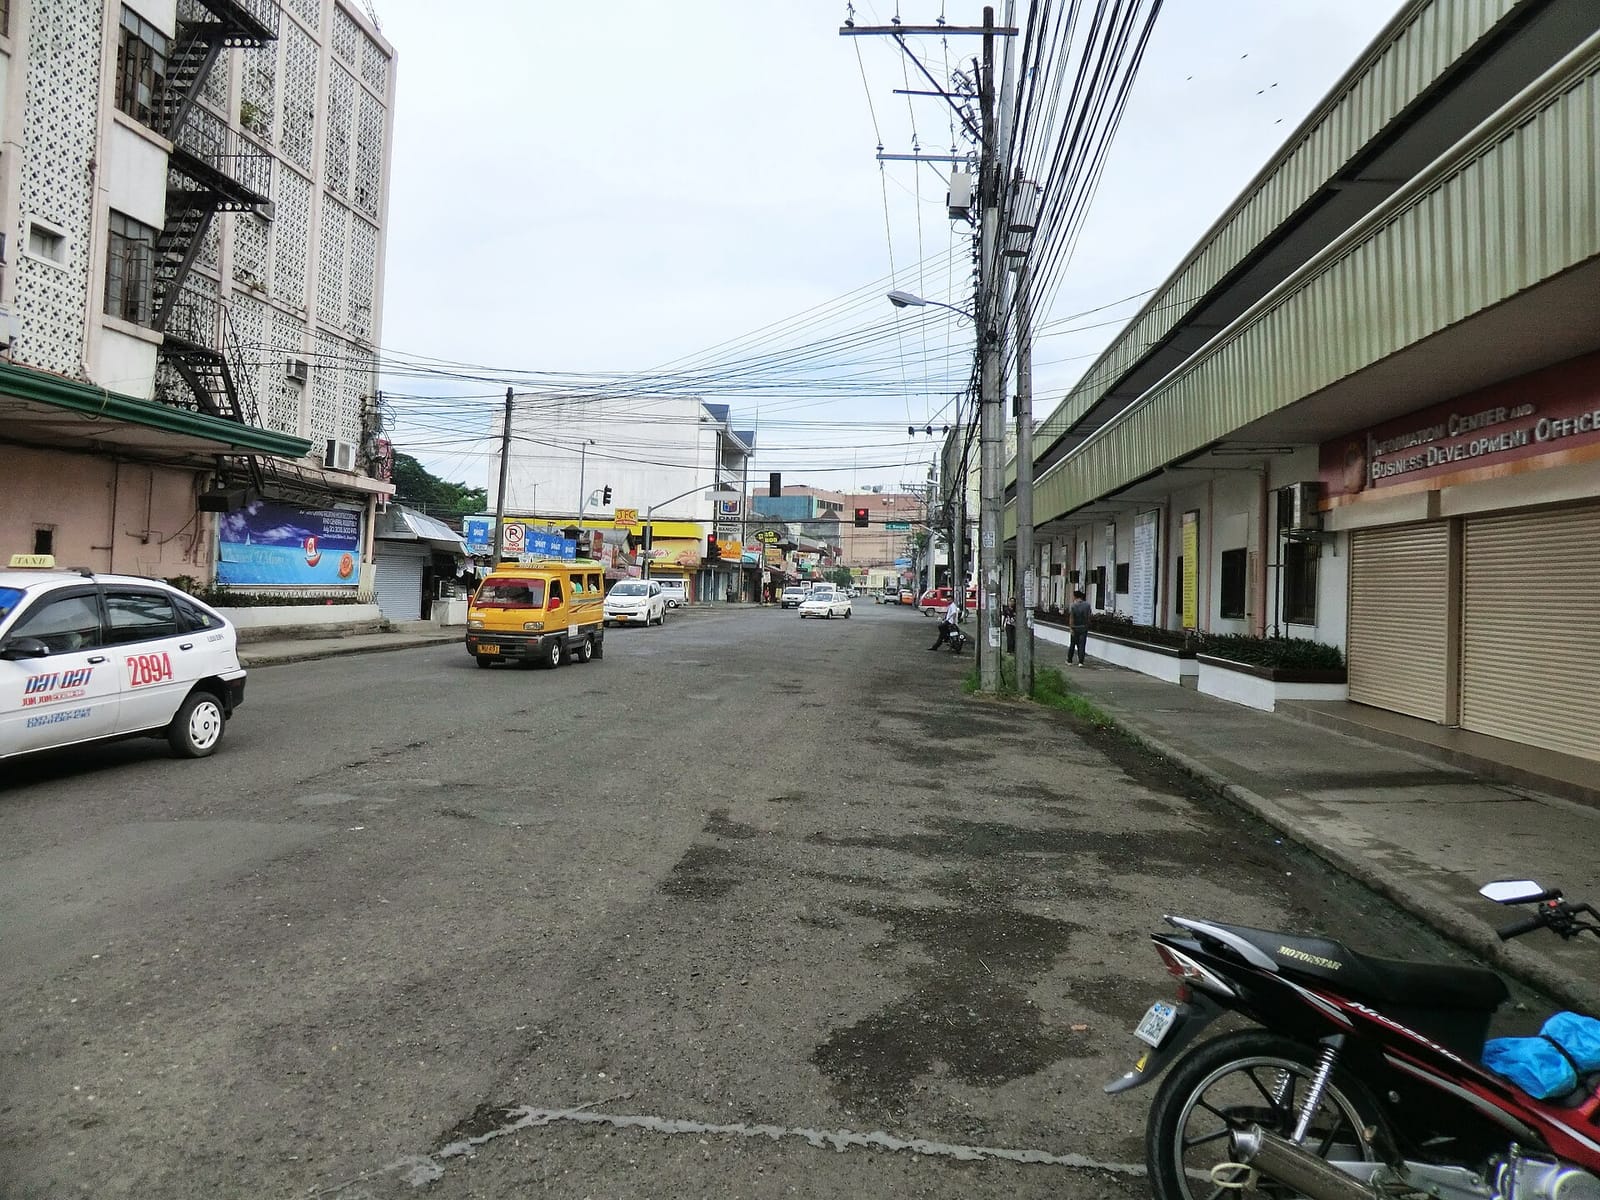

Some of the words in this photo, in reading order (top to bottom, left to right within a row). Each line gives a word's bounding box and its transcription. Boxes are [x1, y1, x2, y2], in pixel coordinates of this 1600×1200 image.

[1448, 406, 1508, 437] CENTER
[1510, 403, 1535, 419] AND
[1372, 454, 1425, 480] BUSINESS
[1426, 428, 1529, 467] DEVELOPMENT
[1535, 409, 1600, 442] OFFICE
[125, 653, 174, 688] 2894
[1277, 946, 1342, 970] MOTORSTAR
